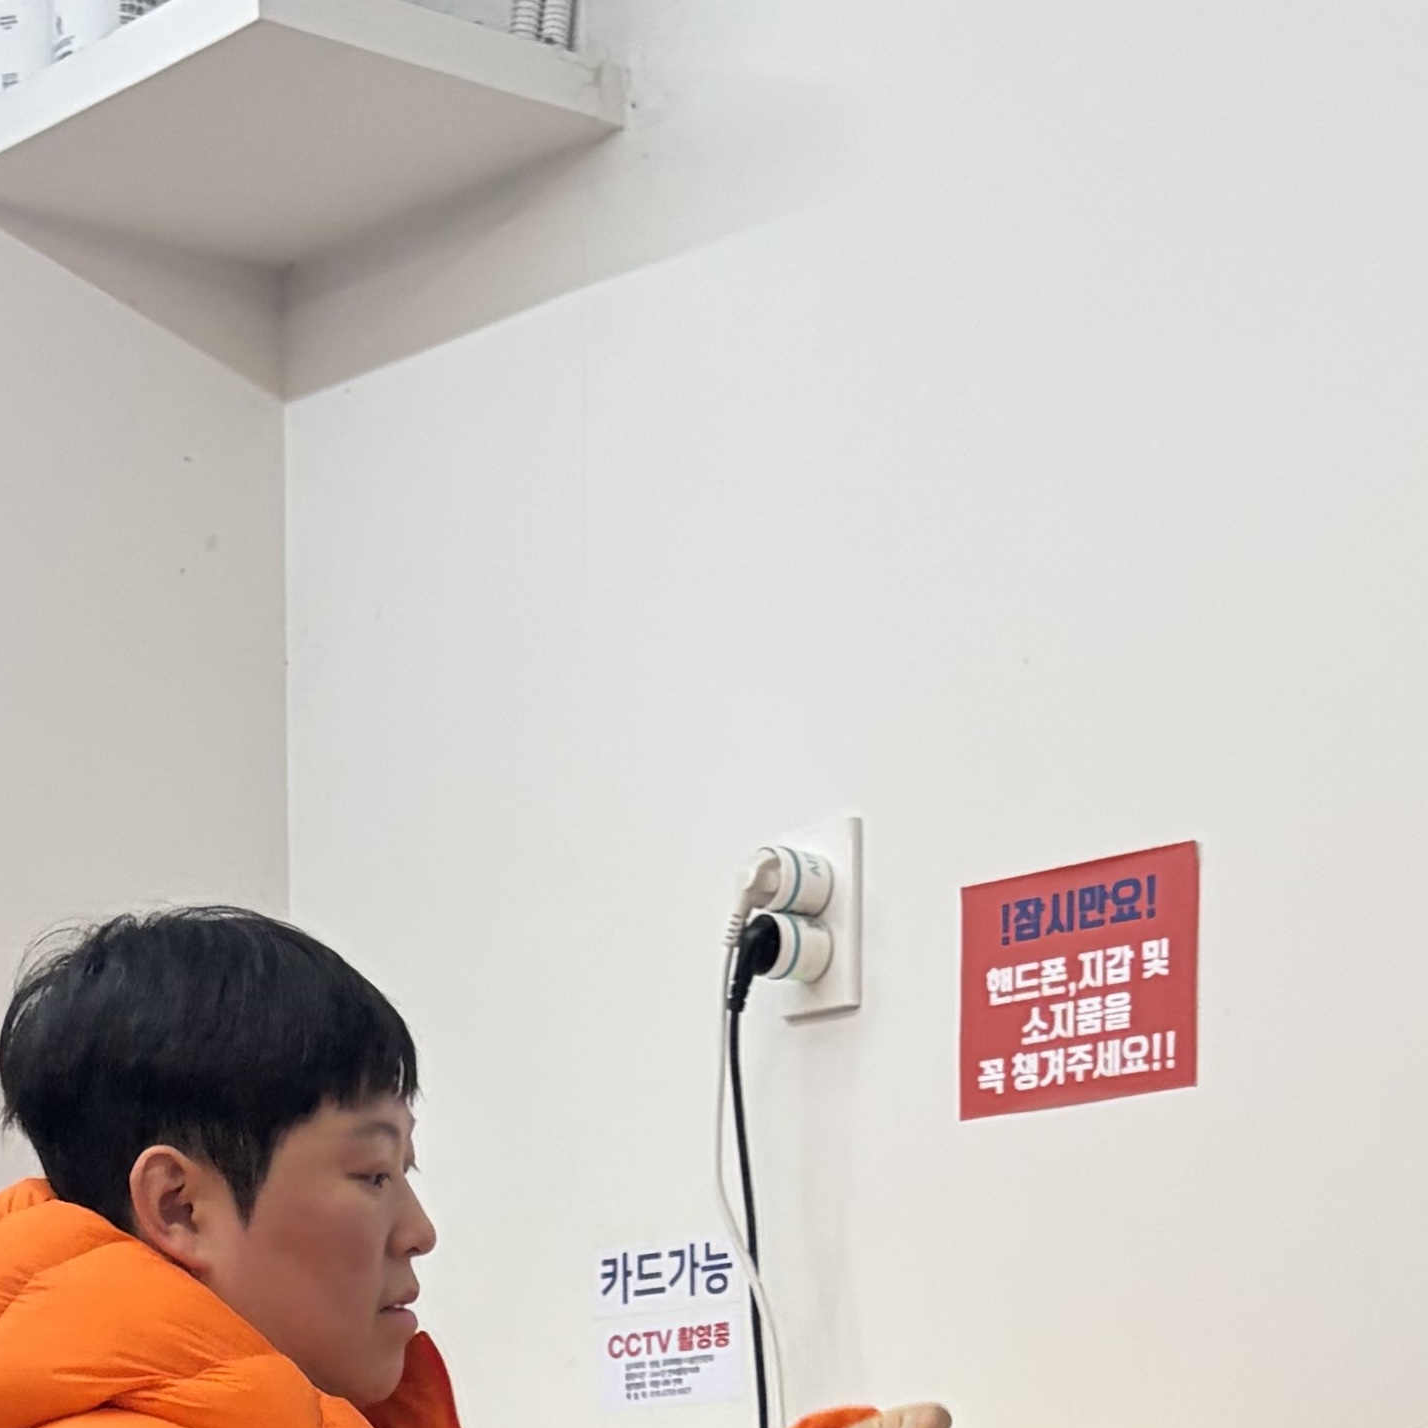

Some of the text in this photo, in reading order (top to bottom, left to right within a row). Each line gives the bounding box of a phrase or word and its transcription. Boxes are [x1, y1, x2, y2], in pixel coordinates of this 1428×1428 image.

[1001, 874, 1156, 946] !잠시만요!
[985, 937, 1170, 1006] 핸드폰,지갑 및
[1021, 991, 1132, 1045] 소지품을
[978, 1030, 1176, 1094] 꼭 챙겨주세요!!
[601, 1242, 733, 1305] 카드가능
[608, 1322, 730, 1359] CCTV 촬영중
